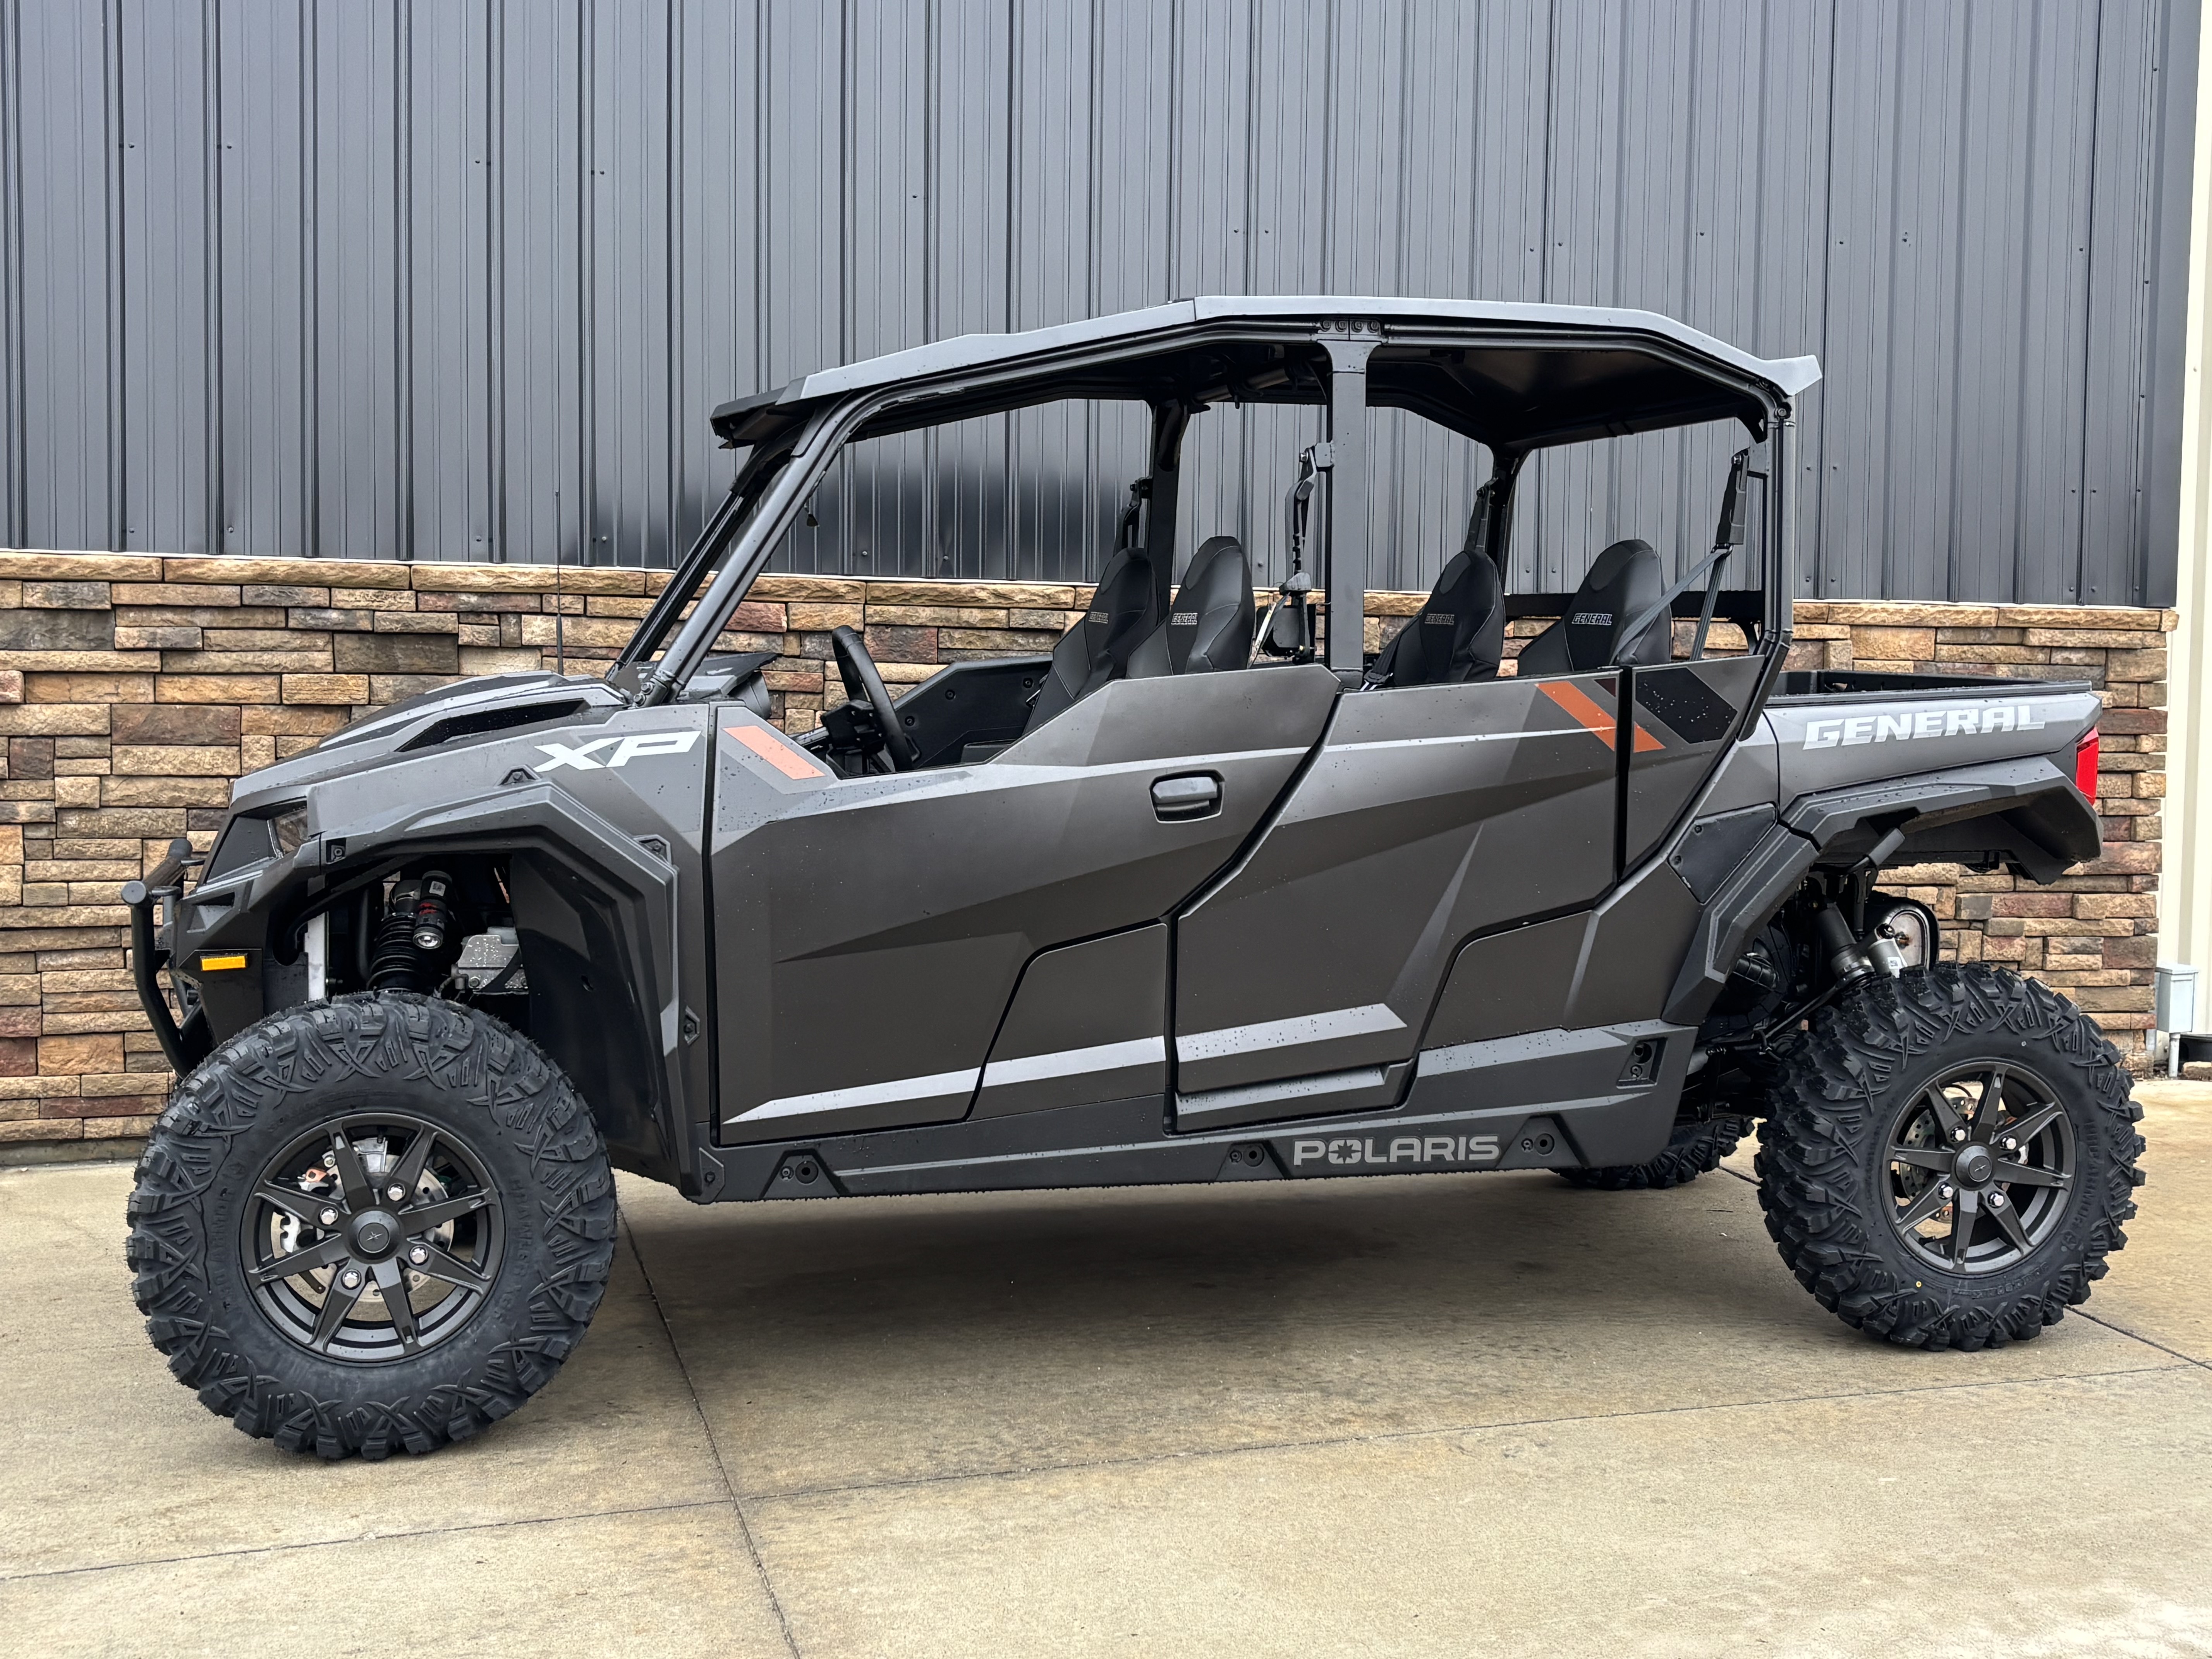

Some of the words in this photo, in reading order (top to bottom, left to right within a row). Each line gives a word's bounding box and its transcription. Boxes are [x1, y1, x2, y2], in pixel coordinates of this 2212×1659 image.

[1424, 613, 1455, 625] GENERAL
[1571, 613, 1613, 625] GENERAL
[1802, 705, 2045, 750] GENERAL
[533, 730, 702, 773] XP
[1293, 1136, 1500, 1166] POLARIS
